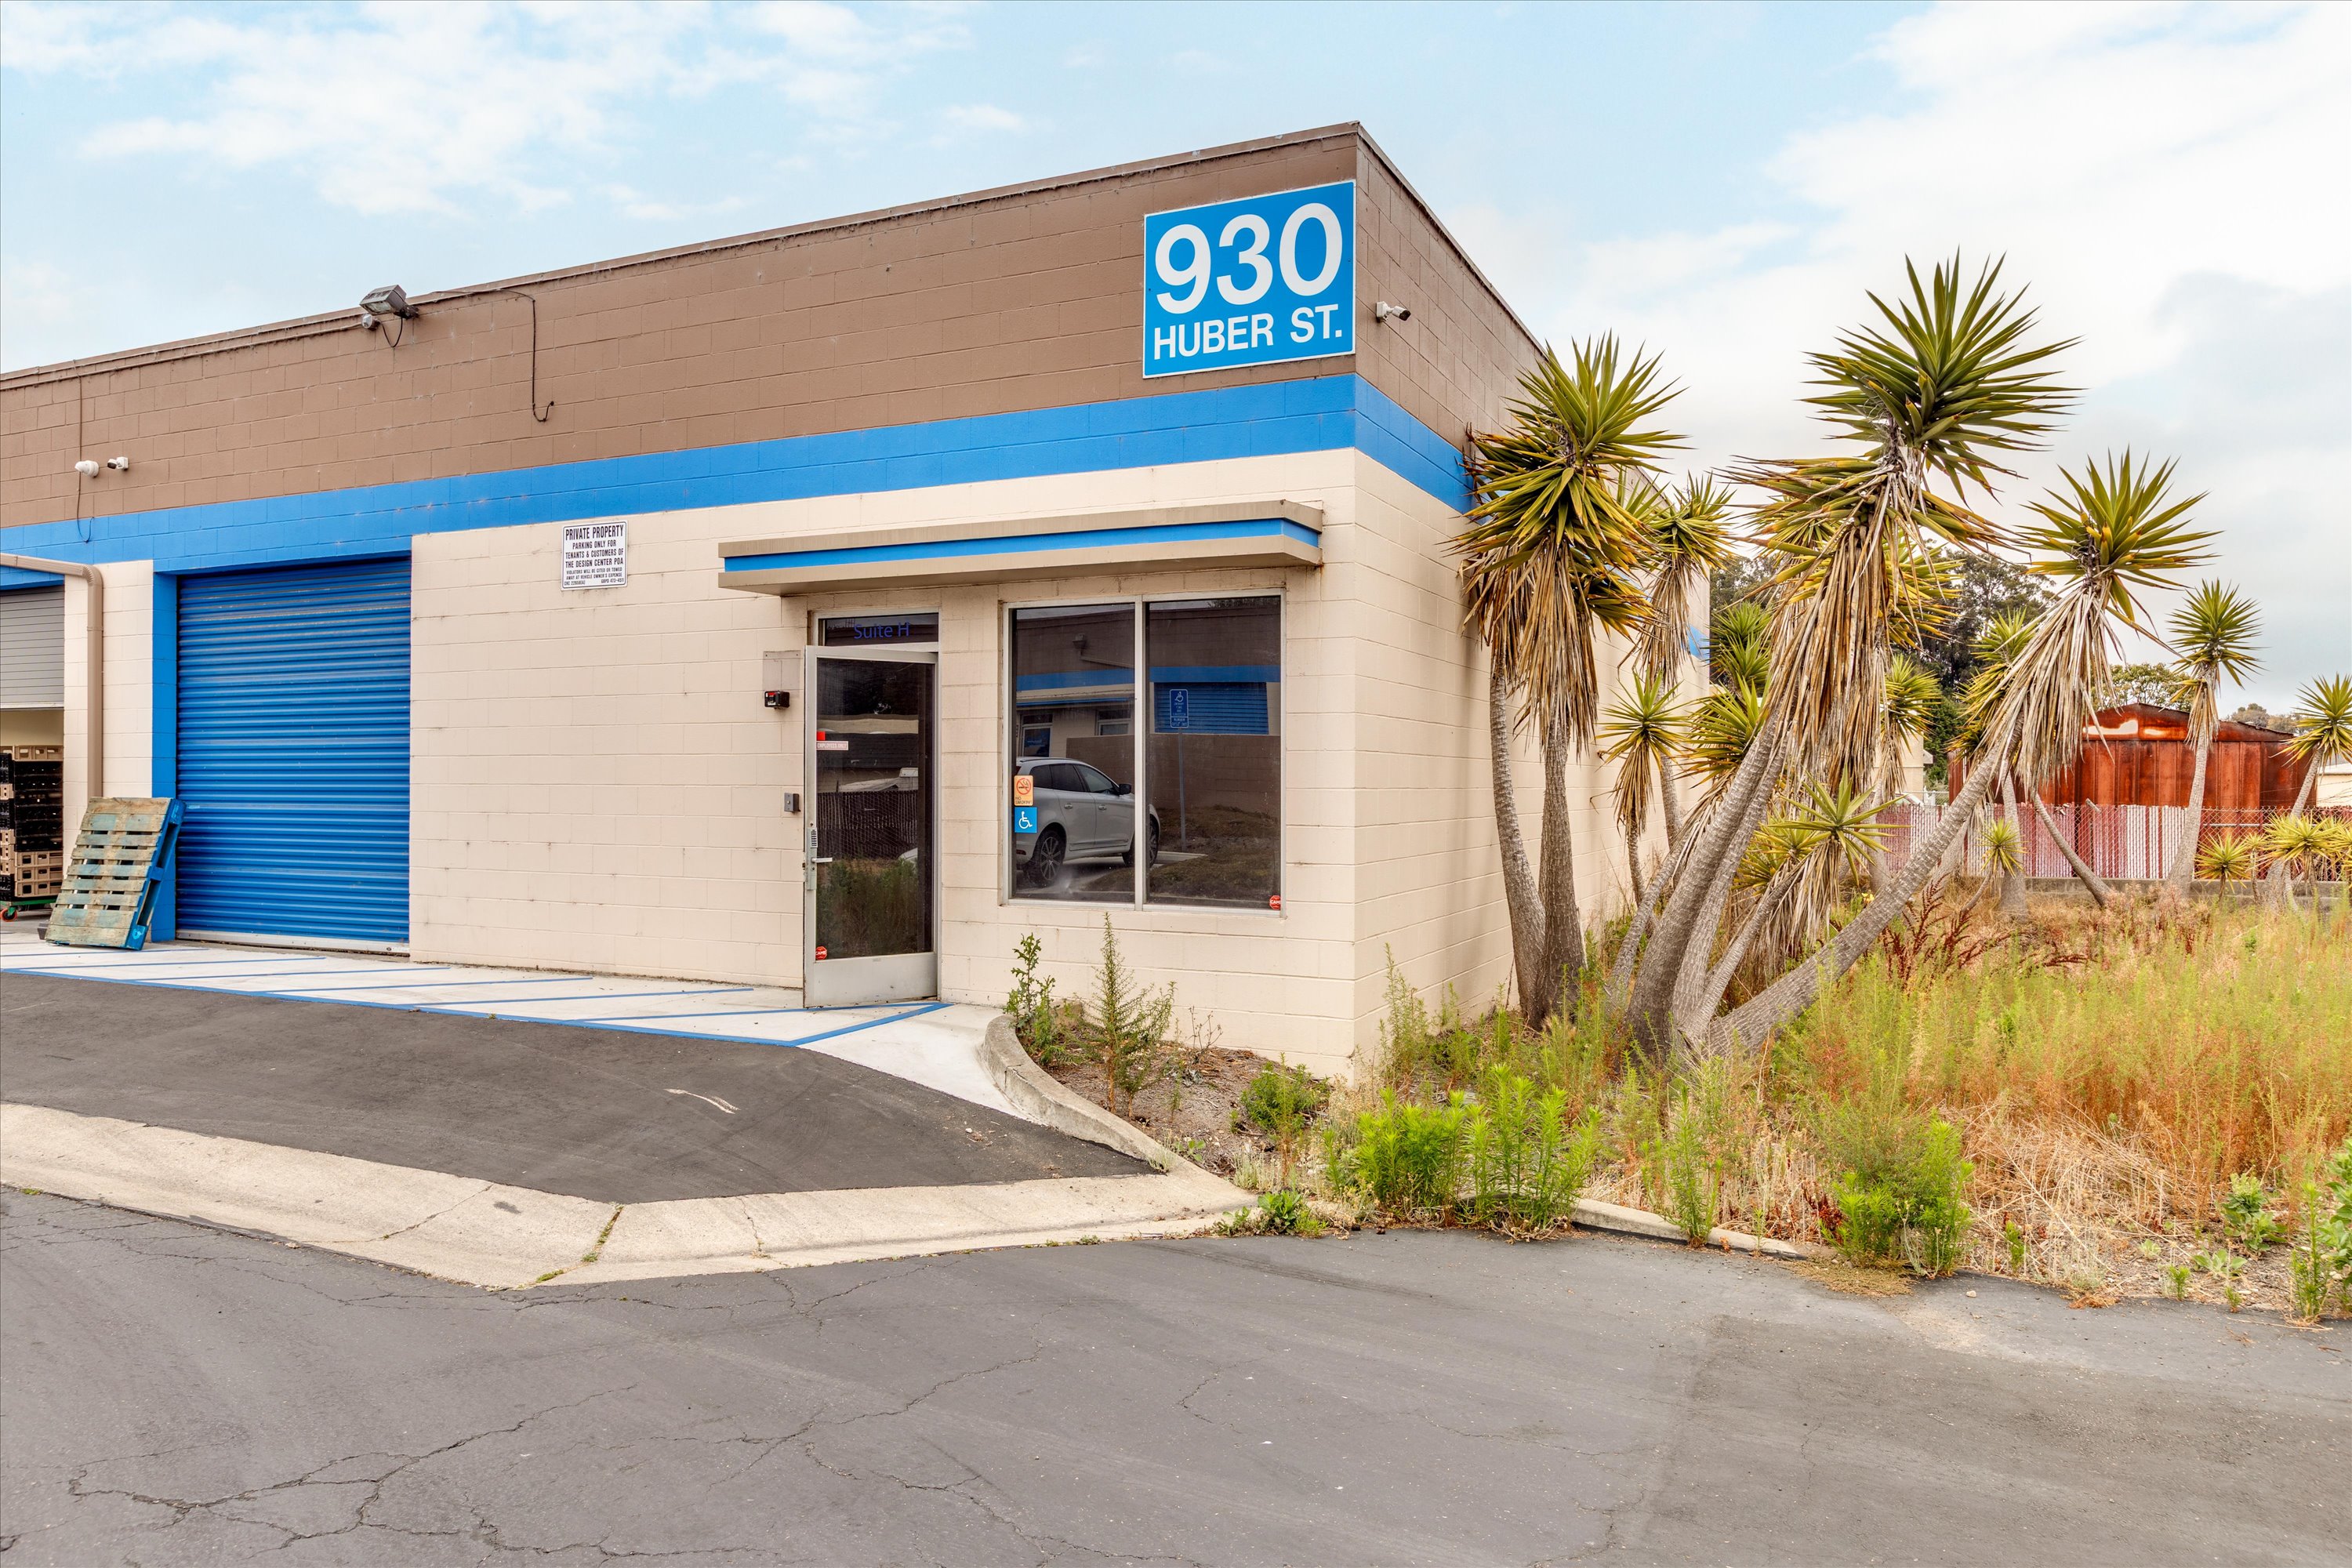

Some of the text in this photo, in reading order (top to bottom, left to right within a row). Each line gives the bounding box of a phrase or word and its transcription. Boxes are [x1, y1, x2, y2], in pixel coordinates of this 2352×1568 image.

[1155, 202, 1343, 314] 930
[1154, 303, 1342, 360] HUBER ST.
[565, 524, 624, 540] PRIVATE PROPERTY
[591, 549, 616, 557] CUSTOMERS
[594, 540, 606, 549] ONLY
[854, 621, 910, 640] Suite H
